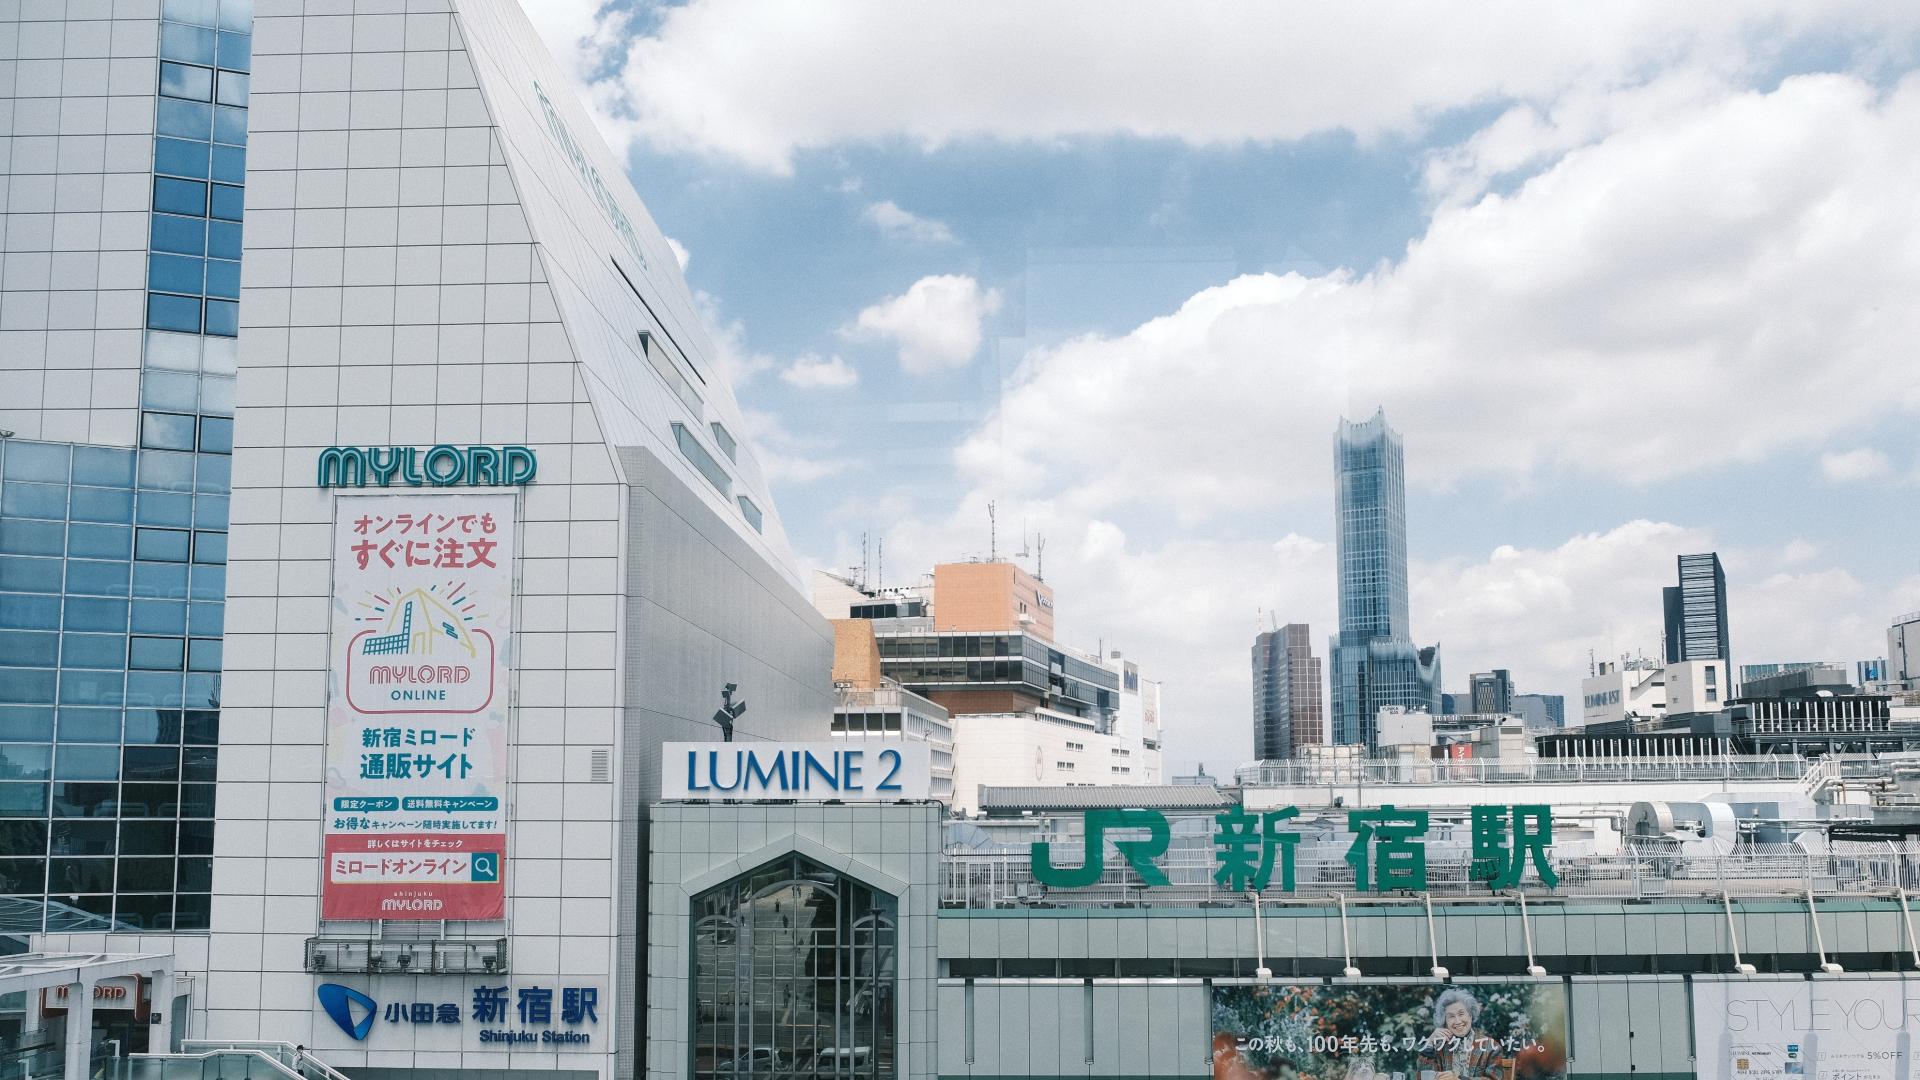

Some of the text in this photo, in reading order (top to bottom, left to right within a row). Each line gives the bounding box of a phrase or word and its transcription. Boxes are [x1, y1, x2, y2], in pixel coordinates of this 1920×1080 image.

[318, 444, 538, 488] MYLORD
[353, 513, 497, 535] オンラインでも
[350, 537, 498, 570] すぐに注文
[369, 664, 471, 685] MYLORD
[390, 689, 446, 701] ONLINE
[362, 727, 476, 748] 新宿ミロード
[359, 752, 473, 779] 通販サイト
[687, 749, 903, 791] LUMINE 2
[340, 799, 393, 809] 限定クーポン
[407, 799, 493, 809] 送料無料キャンペーン
[367, 839, 464, 849] 詳しくはサイトをチェック
[1031, 804, 1559, 892] JR 新宿駅
[336, 857, 468, 876] ミロードオンライン
[381, 898, 443, 911] MYLORD
[56, 985, 127, 999] MORD
[384, 985, 598, 1024] 小田急 新宿駅
[1726, 999, 1831, 1032] STYLE
[479, 1029, 590, 1046] Shinjuku Station
[1235, 1034, 1545, 1054] この秋も、100年先も、ワクワクしていたい。
